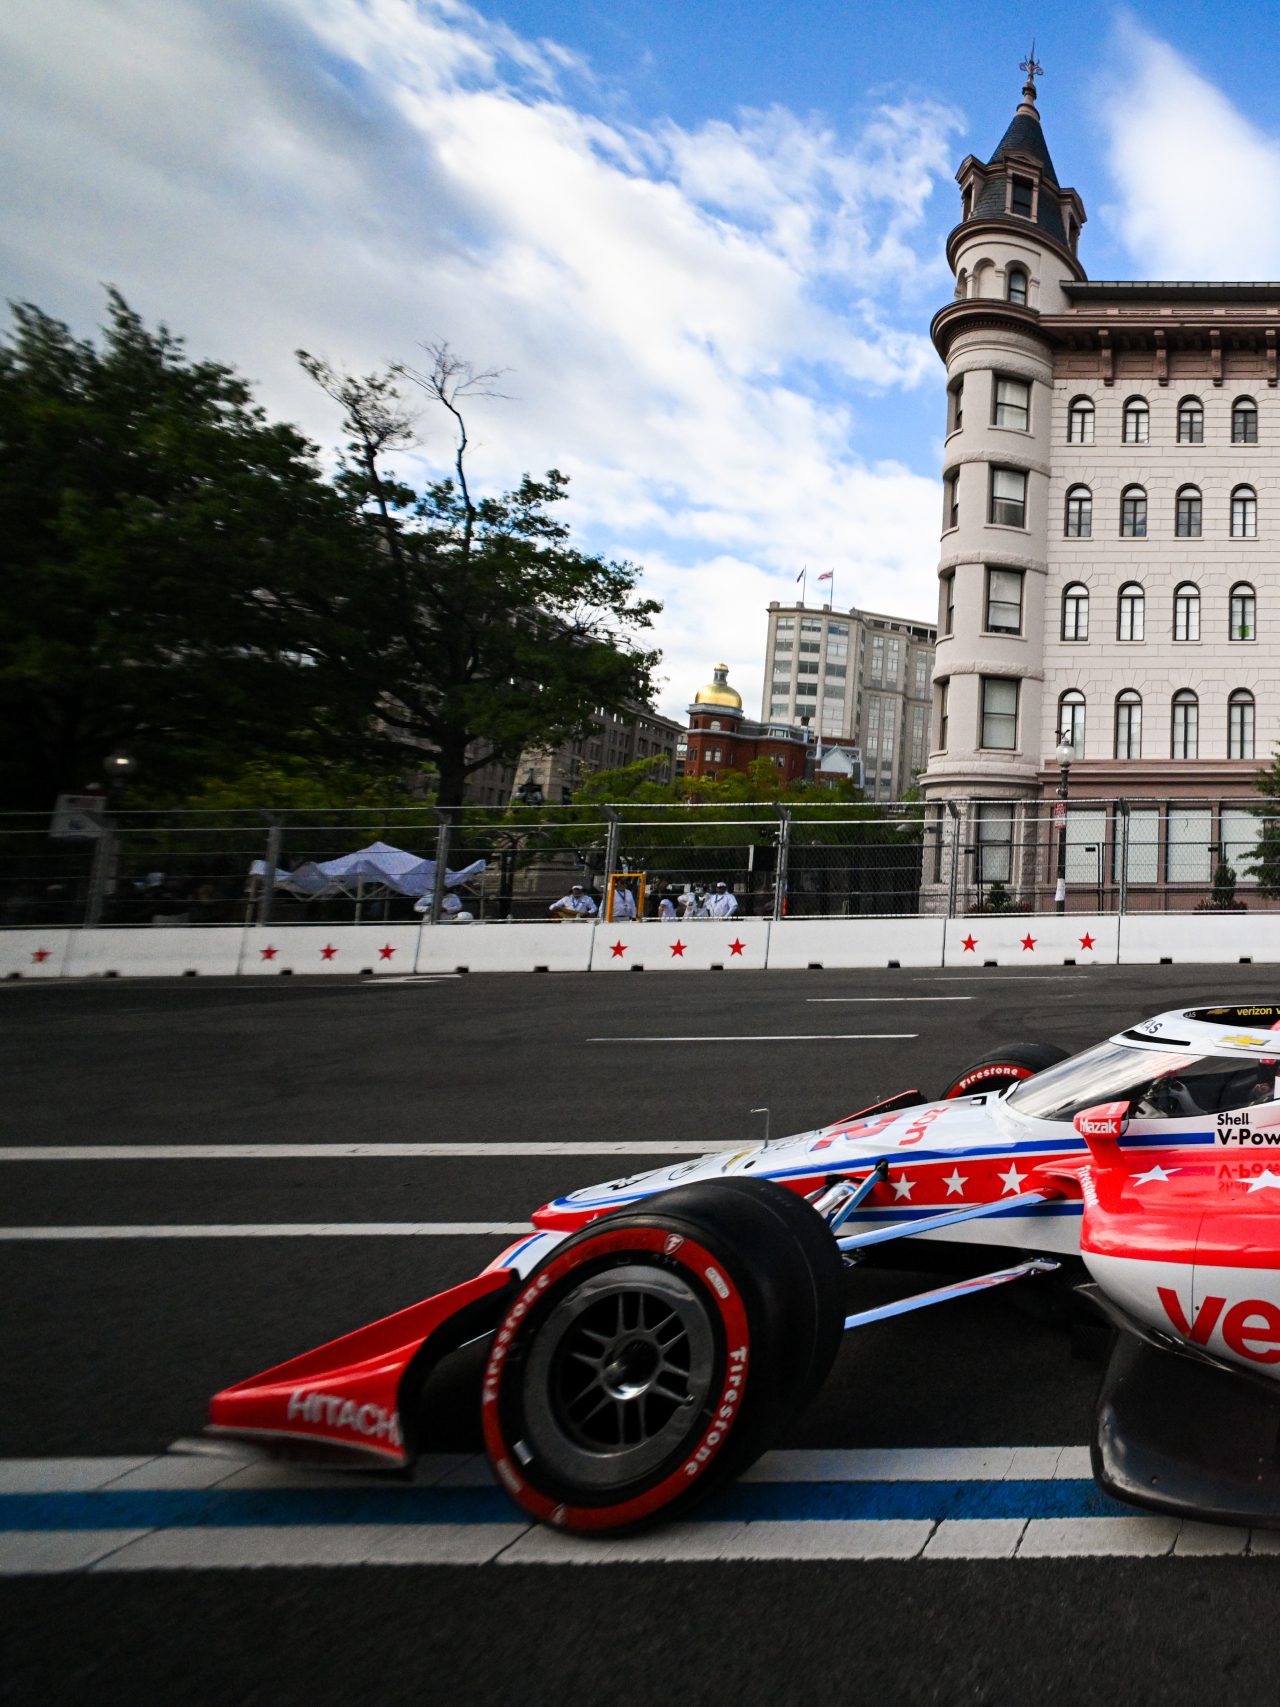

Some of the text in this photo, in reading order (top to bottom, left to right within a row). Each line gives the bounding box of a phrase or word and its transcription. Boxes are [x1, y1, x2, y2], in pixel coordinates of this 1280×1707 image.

[1237, 1006, 1273, 1016] verizon
[959, 1066, 1019, 1090] Firestone
[1080, 1118, 1118, 1134] Mazak
[1217, 1113, 1249, 1126] Shell
[1074, 1164, 1100, 1209] Firestone
[685, 1346, 748, 1476] Firestone
